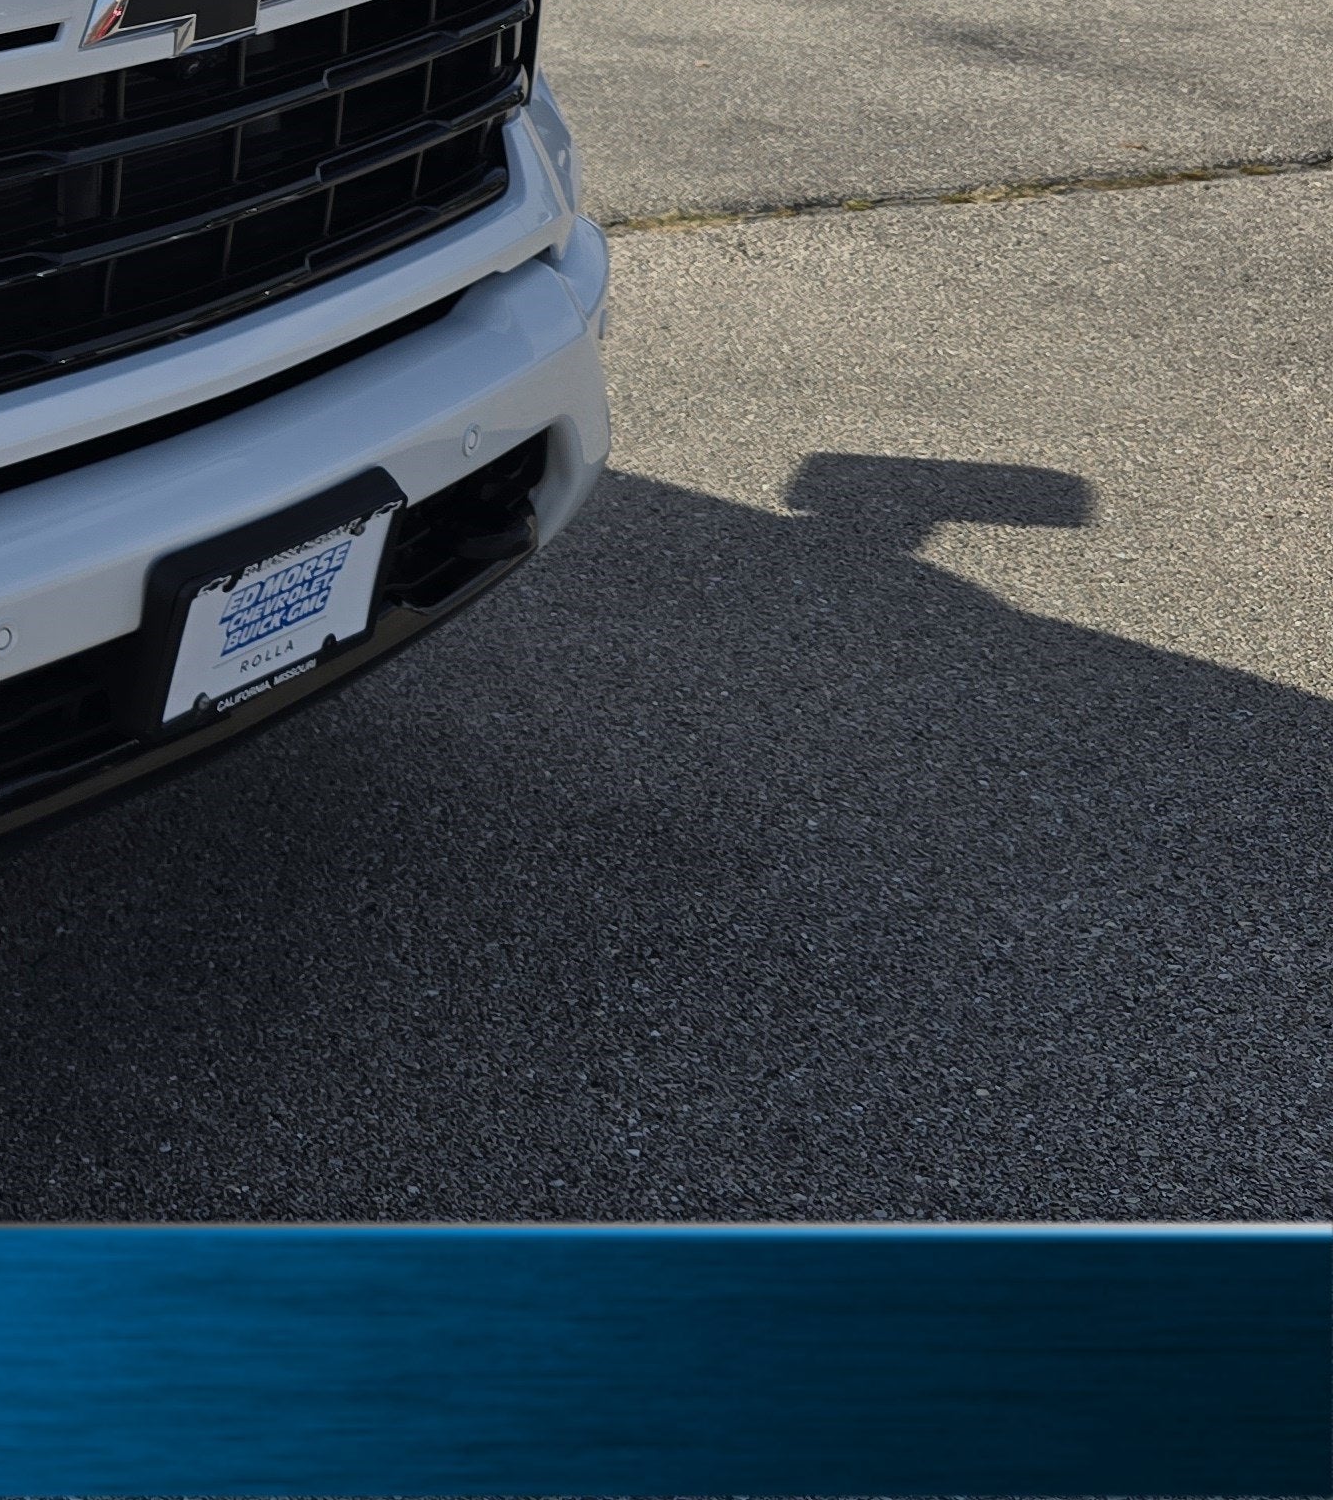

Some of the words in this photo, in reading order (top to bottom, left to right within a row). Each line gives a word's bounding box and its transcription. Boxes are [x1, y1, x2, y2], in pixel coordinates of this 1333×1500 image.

[222, 583, 263, 620] ED
[261, 541, 351, 603] MORSE
[228, 571, 334, 634] CHEVROLET
[239, 639, 295, 674] ROLLA
